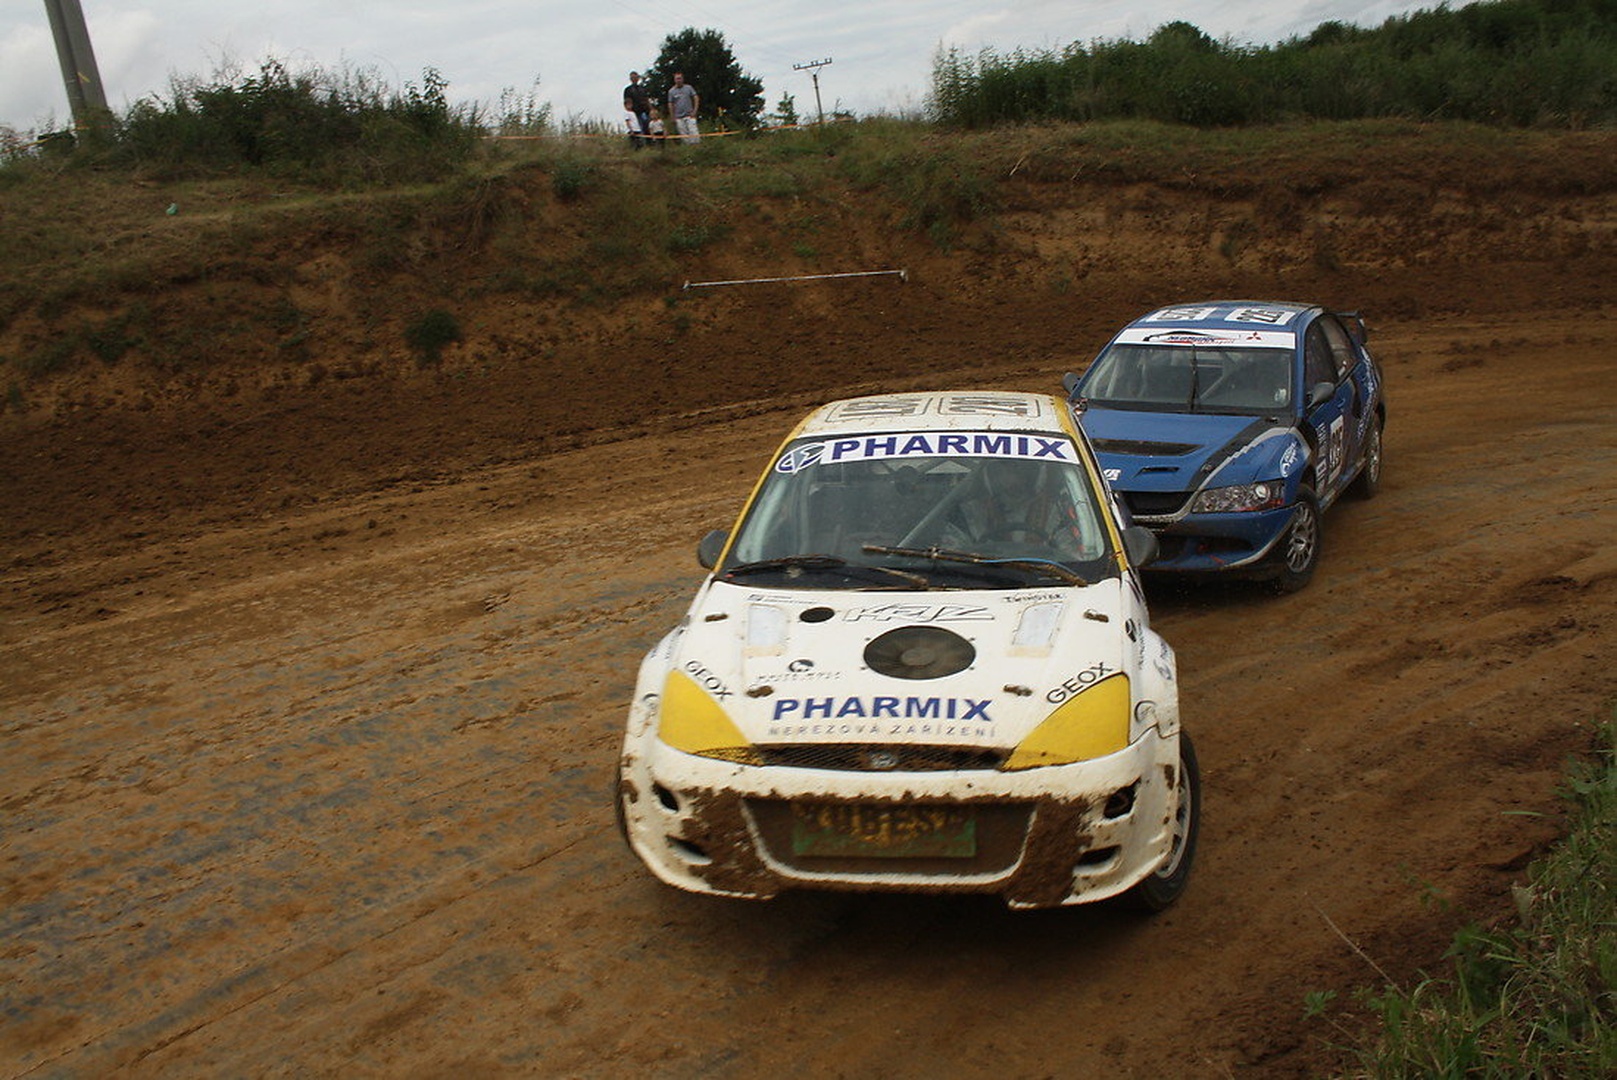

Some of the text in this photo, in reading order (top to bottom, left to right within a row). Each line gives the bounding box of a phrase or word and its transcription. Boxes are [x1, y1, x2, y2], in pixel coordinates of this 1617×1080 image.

[831, 434, 1067, 461] PHARMIX
[686, 660, 733, 701] GEOX
[1046, 661, 1113, 704] GEOX
[772, 697, 993, 722] PHARMIX
